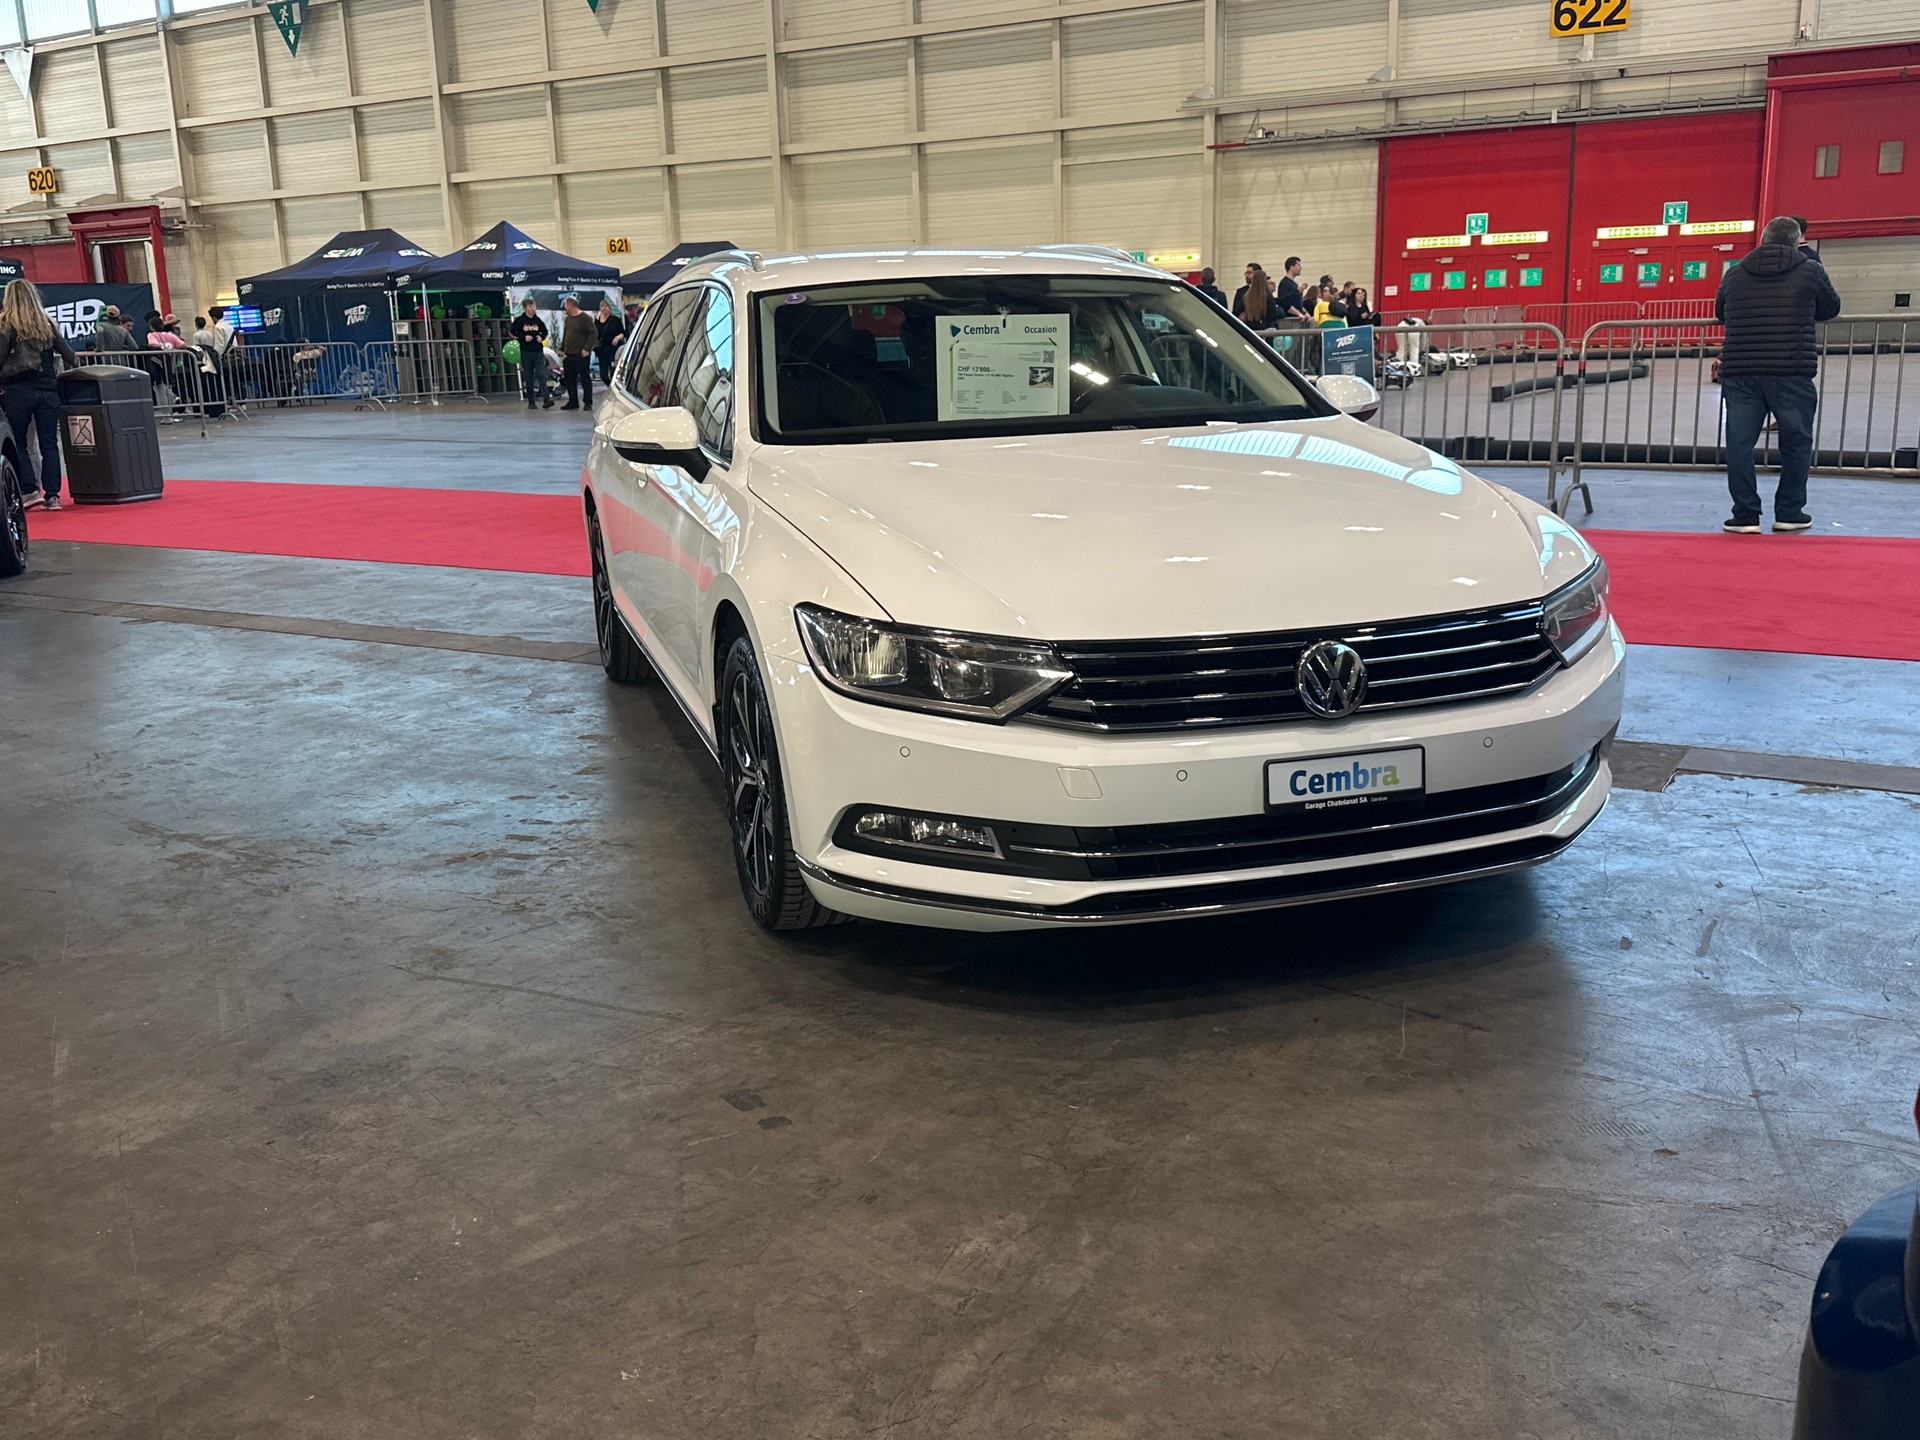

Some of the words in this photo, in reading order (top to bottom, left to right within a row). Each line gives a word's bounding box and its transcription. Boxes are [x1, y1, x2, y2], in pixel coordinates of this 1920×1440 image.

[1554, 0, 1627, 31] 622
[29, 169, 54, 191] 620
[609, 238, 629, 253] 621
[0, 266, 17, 274] ING
[44, 299, 105, 322] EED
[963, 324, 1000, 335] Cembra
[1024, 325, 1057, 334] Occasion
[1289, 761, 1400, 796] Cembra
[1305, 802, 1326, 810] Garage
[1359, 796, 1368, 804] SA
